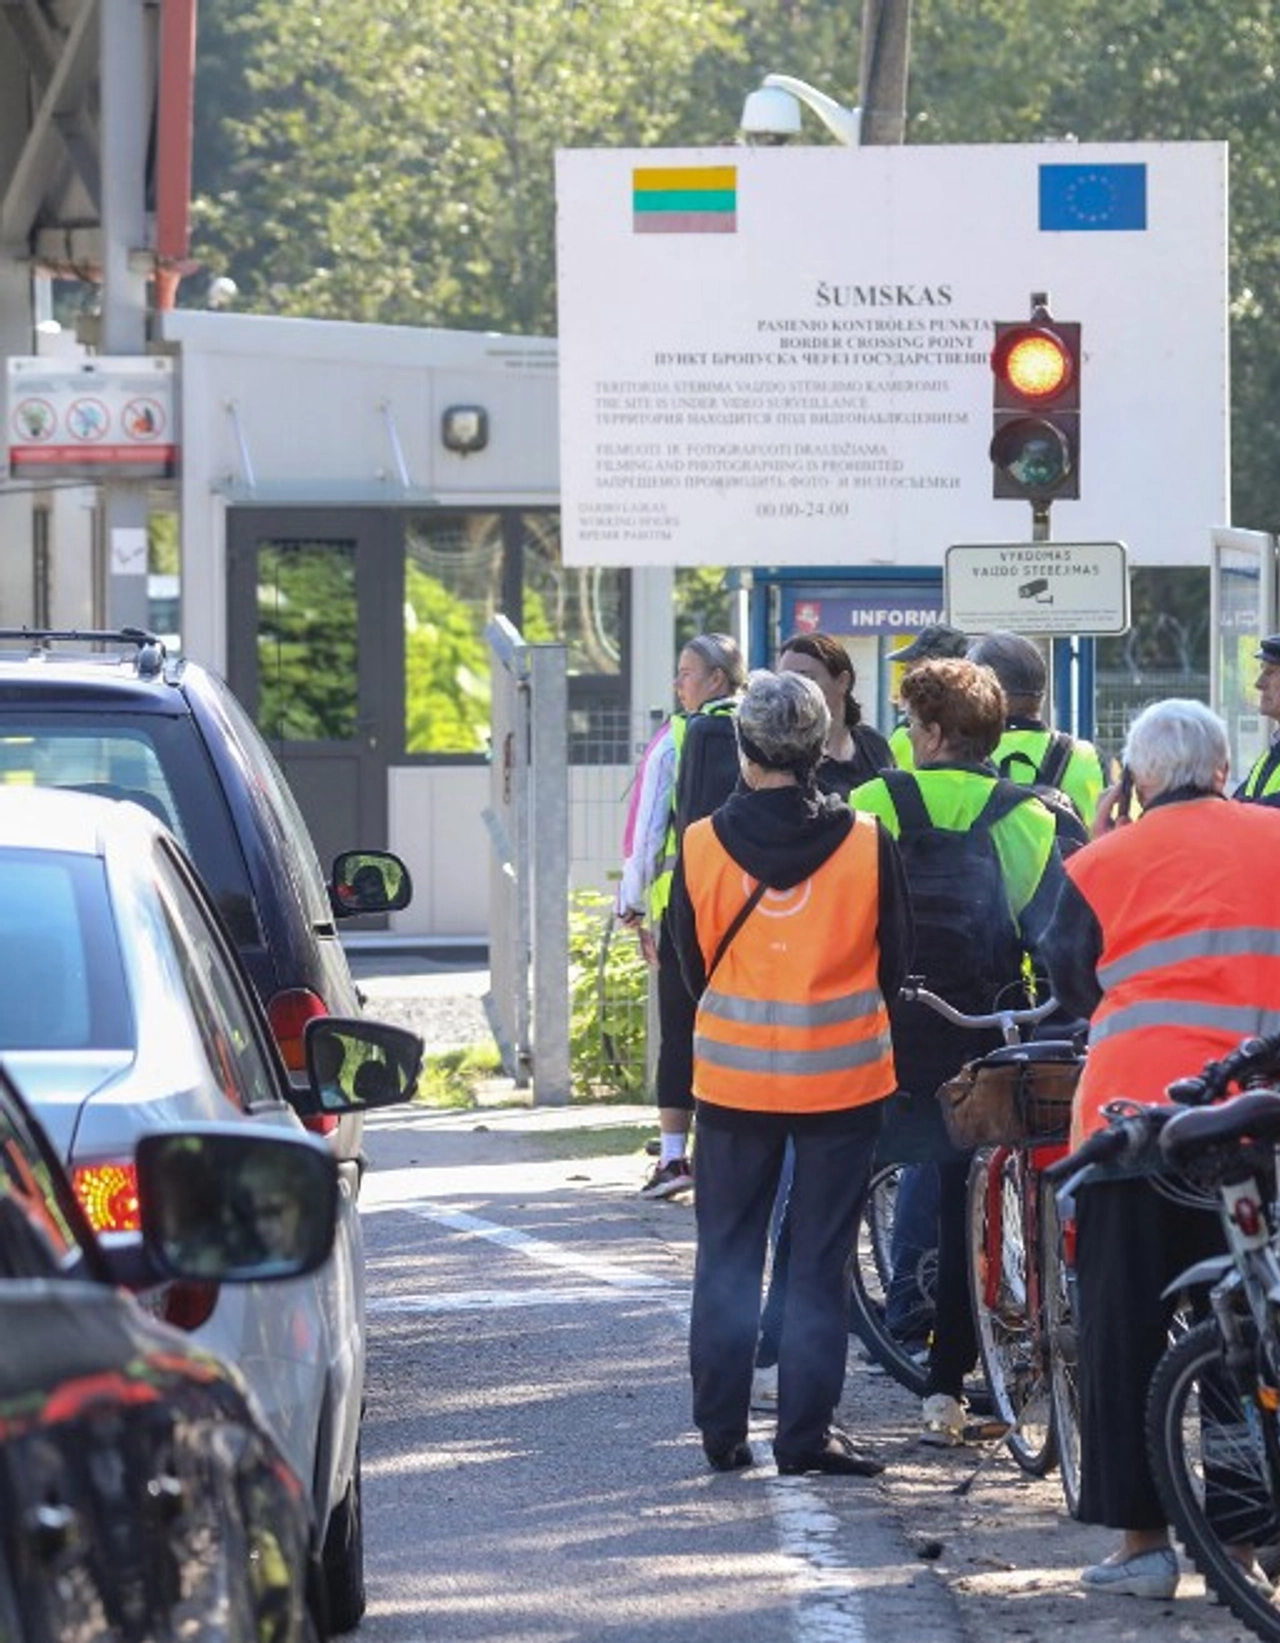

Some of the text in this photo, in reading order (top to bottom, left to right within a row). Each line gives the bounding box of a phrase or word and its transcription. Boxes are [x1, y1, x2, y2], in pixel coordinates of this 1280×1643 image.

[816, 280, 953, 307] ŠUMSKAS
[757, 318, 828, 332] PASIENIO
[779, 335, 974, 349] BORDER CROSSING POINT
[596, 397, 621, 409] THE
[625, 397, 650, 409] SITE
[673, 397, 717, 409] UNDER
[722, 397, 764, 409] VIDEO
[767, 396, 868, 409] SURVEILLANCE
[596, 459, 653, 472] FILMING
[655, 459, 685, 472] AND
[687, 459, 803, 472] PHOTOGRAPHING
[822, 459, 903, 472] PROHIBITED
[999, 550, 1072, 561] VYKDOMAS
[851, 610, 947, 626] INFORMA
